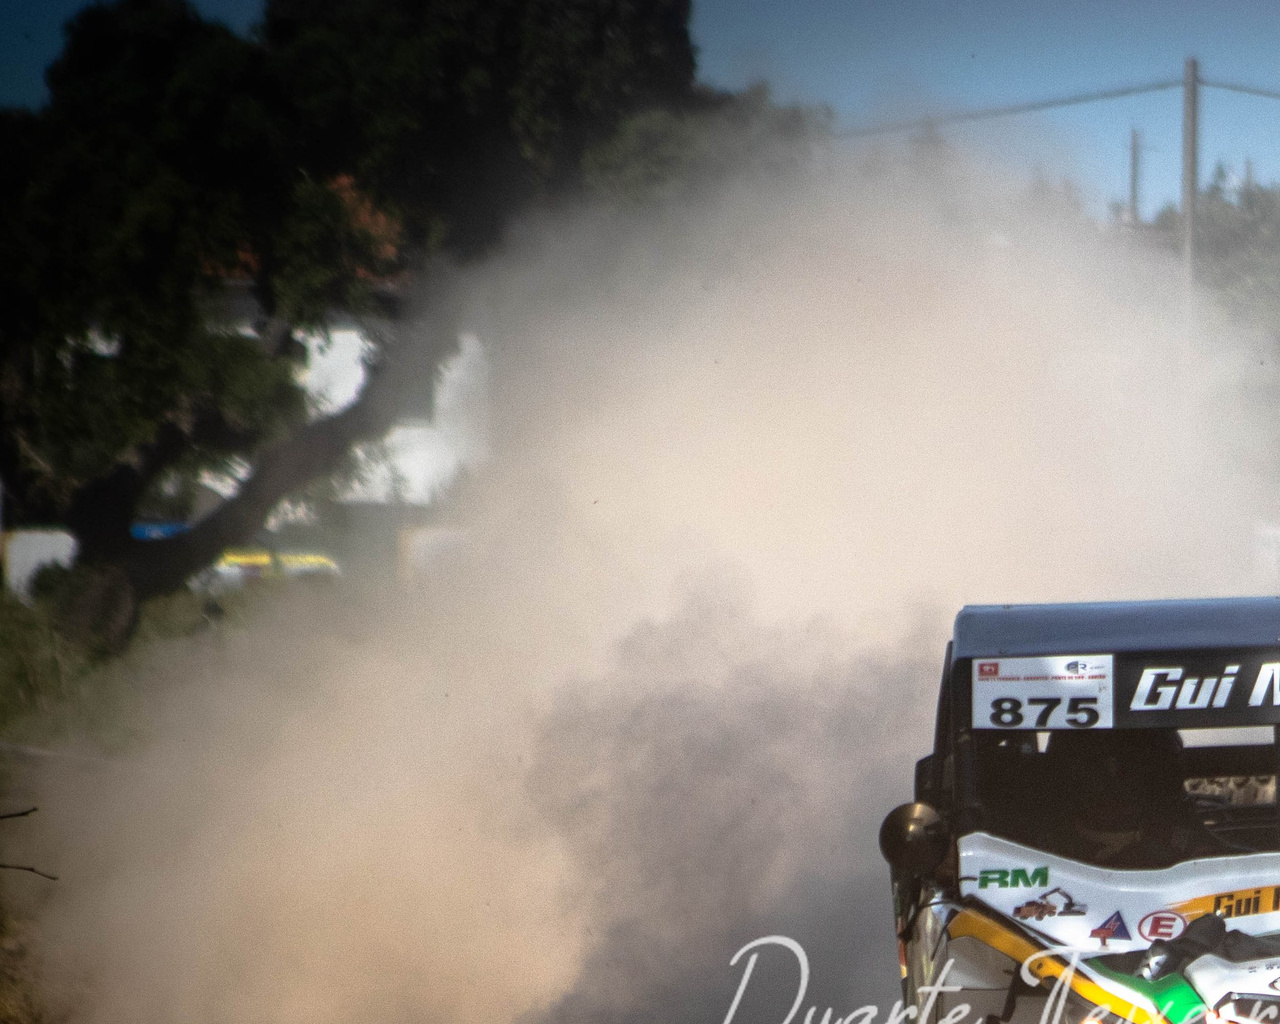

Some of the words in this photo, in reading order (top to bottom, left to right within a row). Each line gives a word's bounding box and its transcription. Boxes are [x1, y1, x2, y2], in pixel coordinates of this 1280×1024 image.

[1129, 665, 1241, 711] Gui
[989, 697, 1100, 729] 875
[977, 866, 1050, 889] RM
[1213, 890, 1261, 919] Gui
[1149, 915, 1178, 938] E
